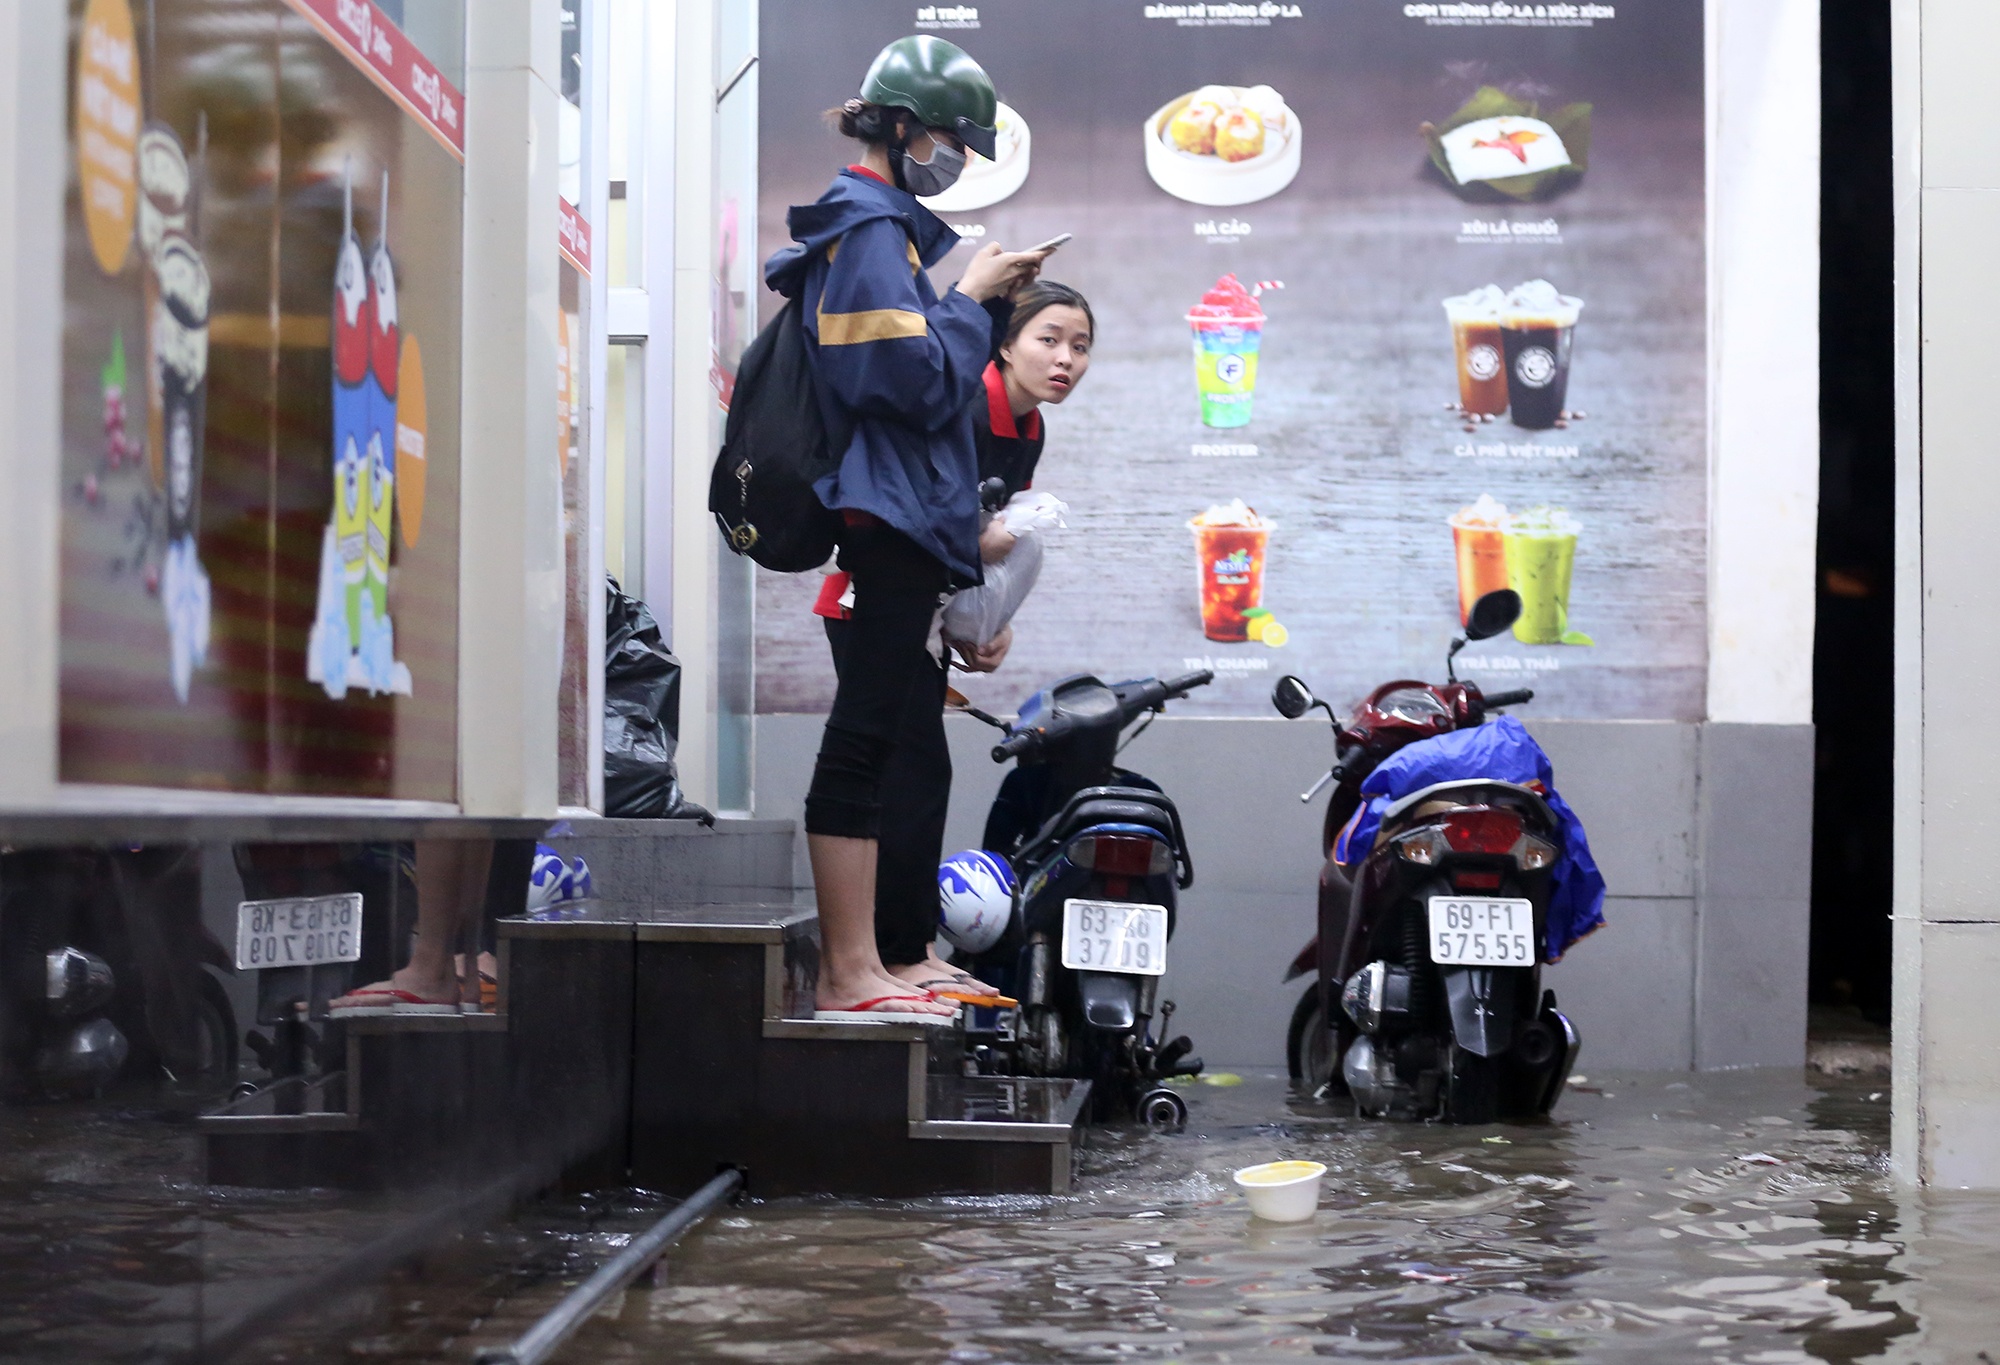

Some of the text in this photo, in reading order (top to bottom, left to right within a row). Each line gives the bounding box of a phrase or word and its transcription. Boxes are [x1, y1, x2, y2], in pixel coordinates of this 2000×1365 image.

[1144, 3, 1187, 18] BÁNH
[1281, 5, 1302, 18] LA
[1514, 5, 1535, 17] LA
[1194, 219, 1218, 235] HÁ
[1490, 219, 1511, 235] LÁ
[1191, 444, 1259, 457] FROSTER
[1454, 441, 1580, 460] CÀ PHÊ VIỆT NAM
[1183, 655, 1268, 671] TRÀ CHANH
[1459, 655, 1489, 671] TRÀ
[1524, 655, 1560, 671] THÁI
[1446, 903, 1513, 931] 69-F1
[1438, 932, 1527, 961] 575.55
